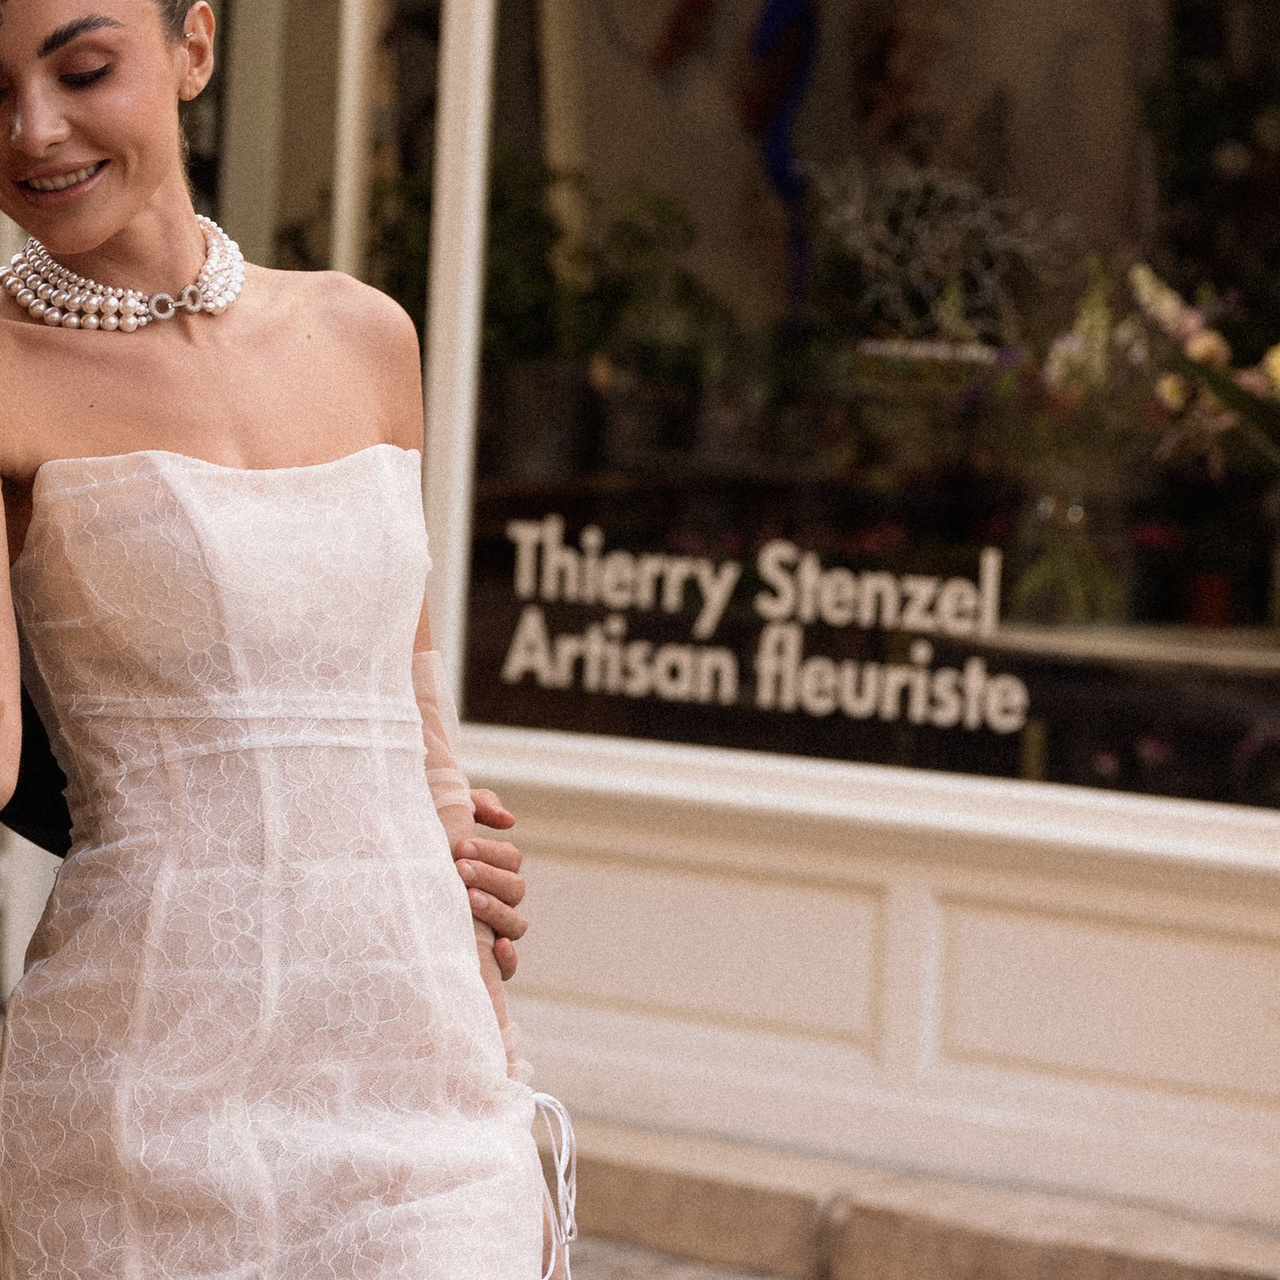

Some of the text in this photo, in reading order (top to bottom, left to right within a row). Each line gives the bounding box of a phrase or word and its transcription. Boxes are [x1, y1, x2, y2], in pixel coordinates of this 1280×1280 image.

[506, 514, 1003, 640] Thierry Stenzel
[502, 606, 1029, 734] Artisan fleuriste
